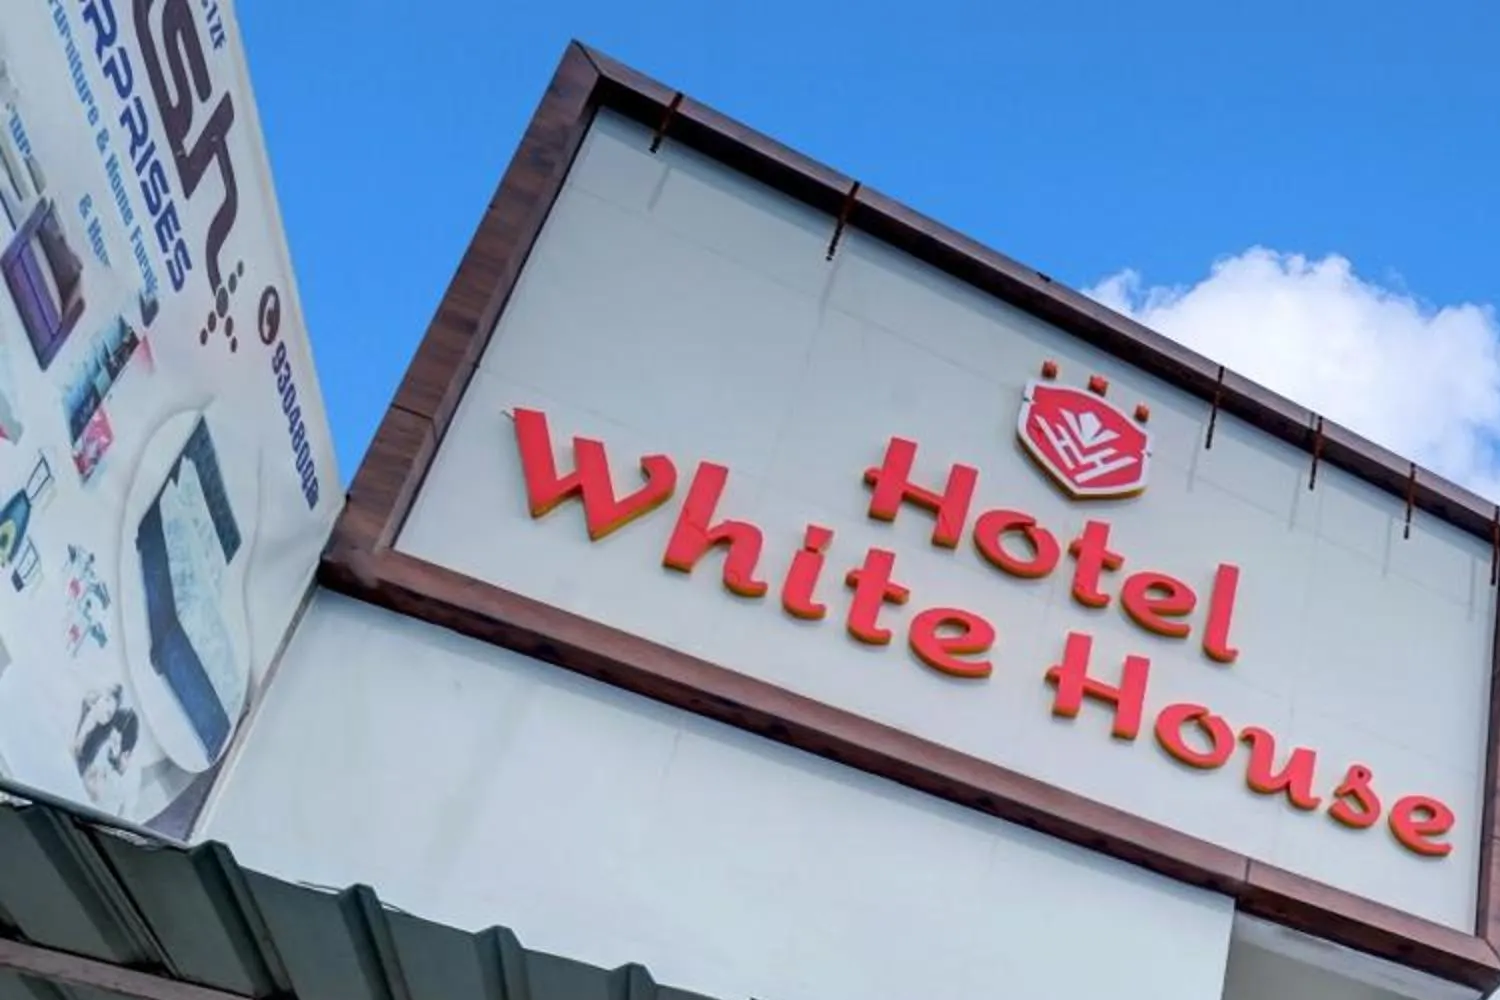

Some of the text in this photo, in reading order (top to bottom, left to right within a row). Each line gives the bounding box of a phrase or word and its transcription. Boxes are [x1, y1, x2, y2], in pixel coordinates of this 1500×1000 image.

[48, 0, 99, 128] urniture
[105, 153, 134, 227] Home
[79, 0, 193, 293] RPRISES
[510, 406, 1456, 857] White House
[864, 436, 1240, 664] Hotel
